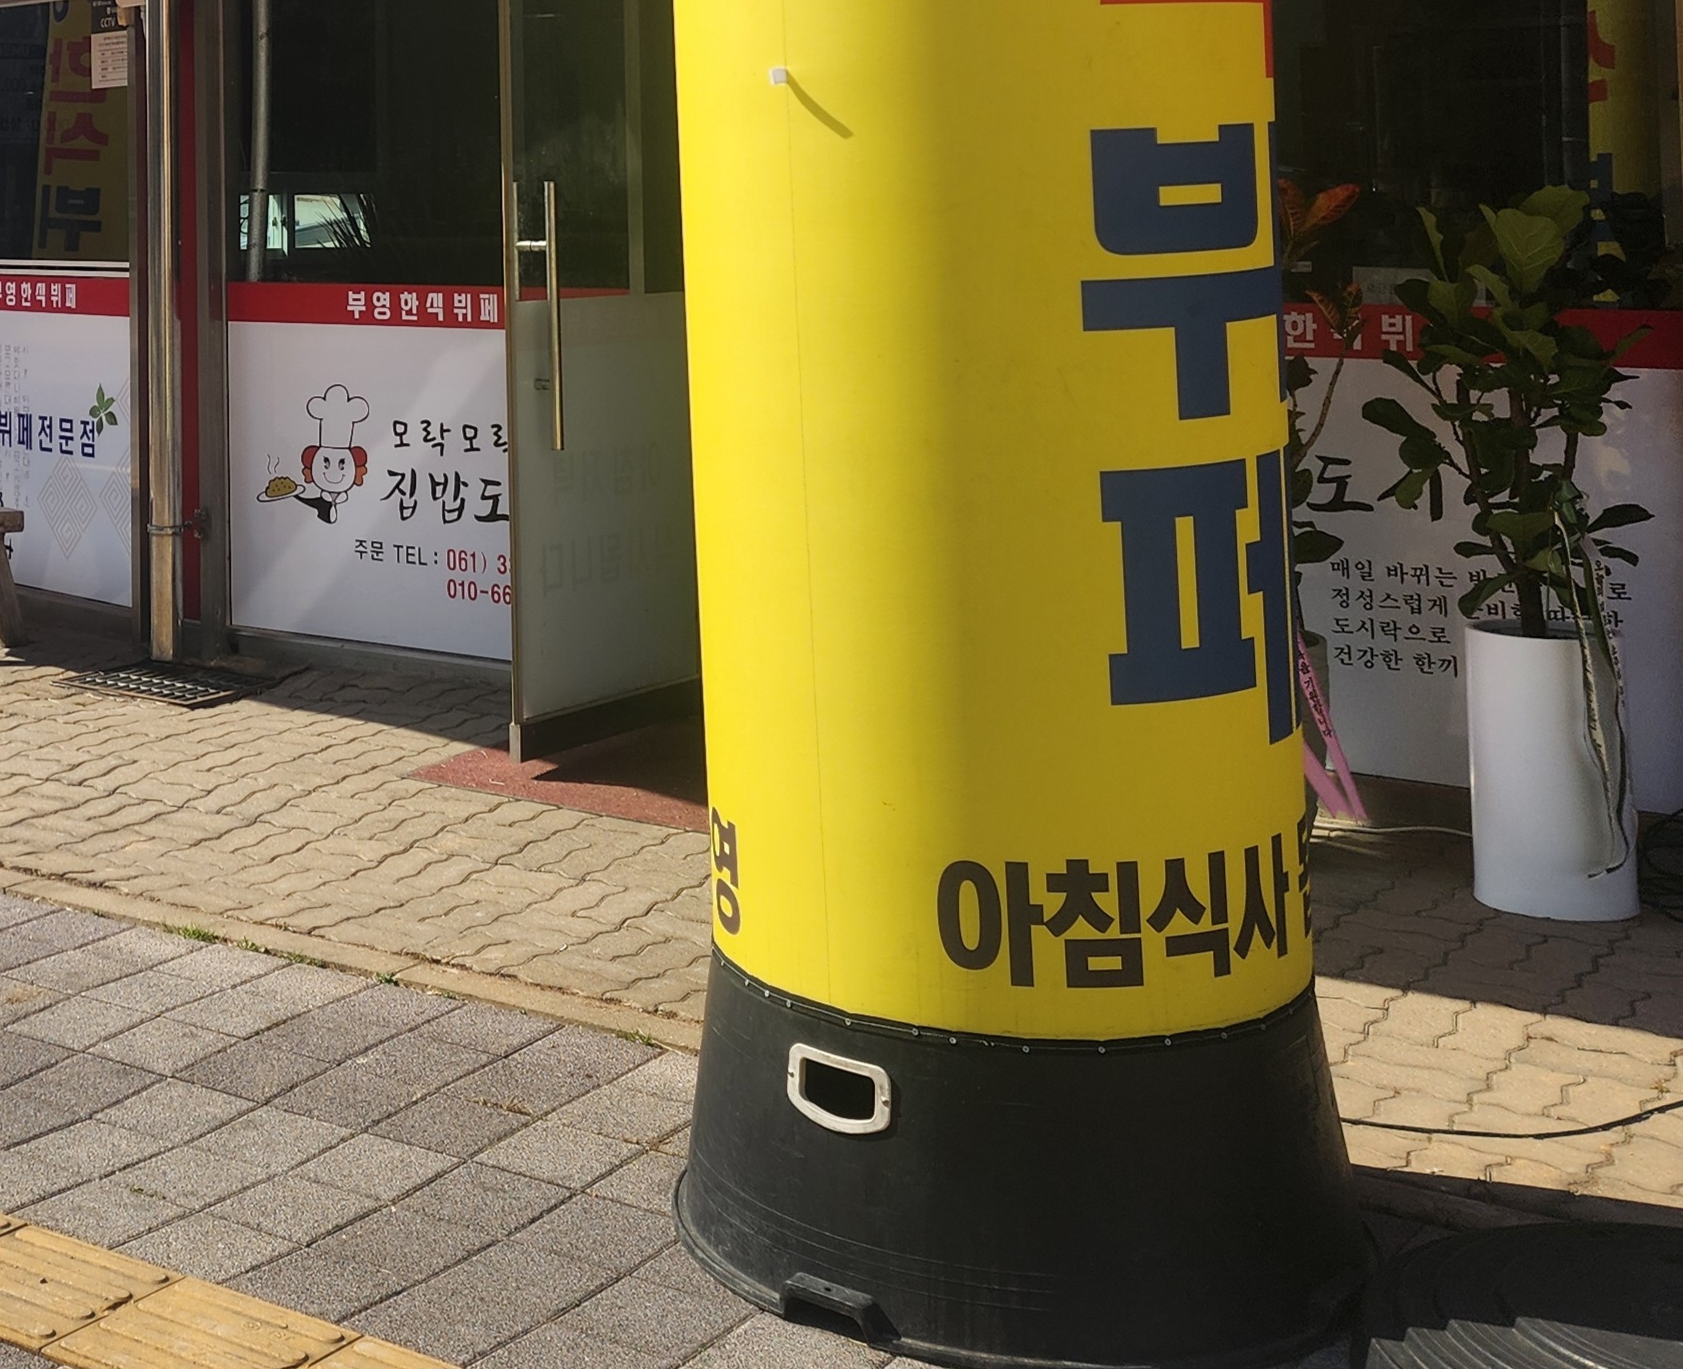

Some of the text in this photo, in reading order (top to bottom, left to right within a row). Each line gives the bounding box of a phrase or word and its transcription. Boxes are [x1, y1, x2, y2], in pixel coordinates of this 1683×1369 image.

[346, 290, 499, 324] 부영한식뷔페
[354, 538, 384, 563] 주문
[1330, 557, 1375, 582] 매일
[1331, 586, 1448, 618] 정성스럽게
[1331, 617, 1452, 644] 도시락으로
[1333, 644, 1403, 672] 건강한
[1413, 652, 1459, 679] 한끼
[936, 833, 1290, 989] 아침식사
